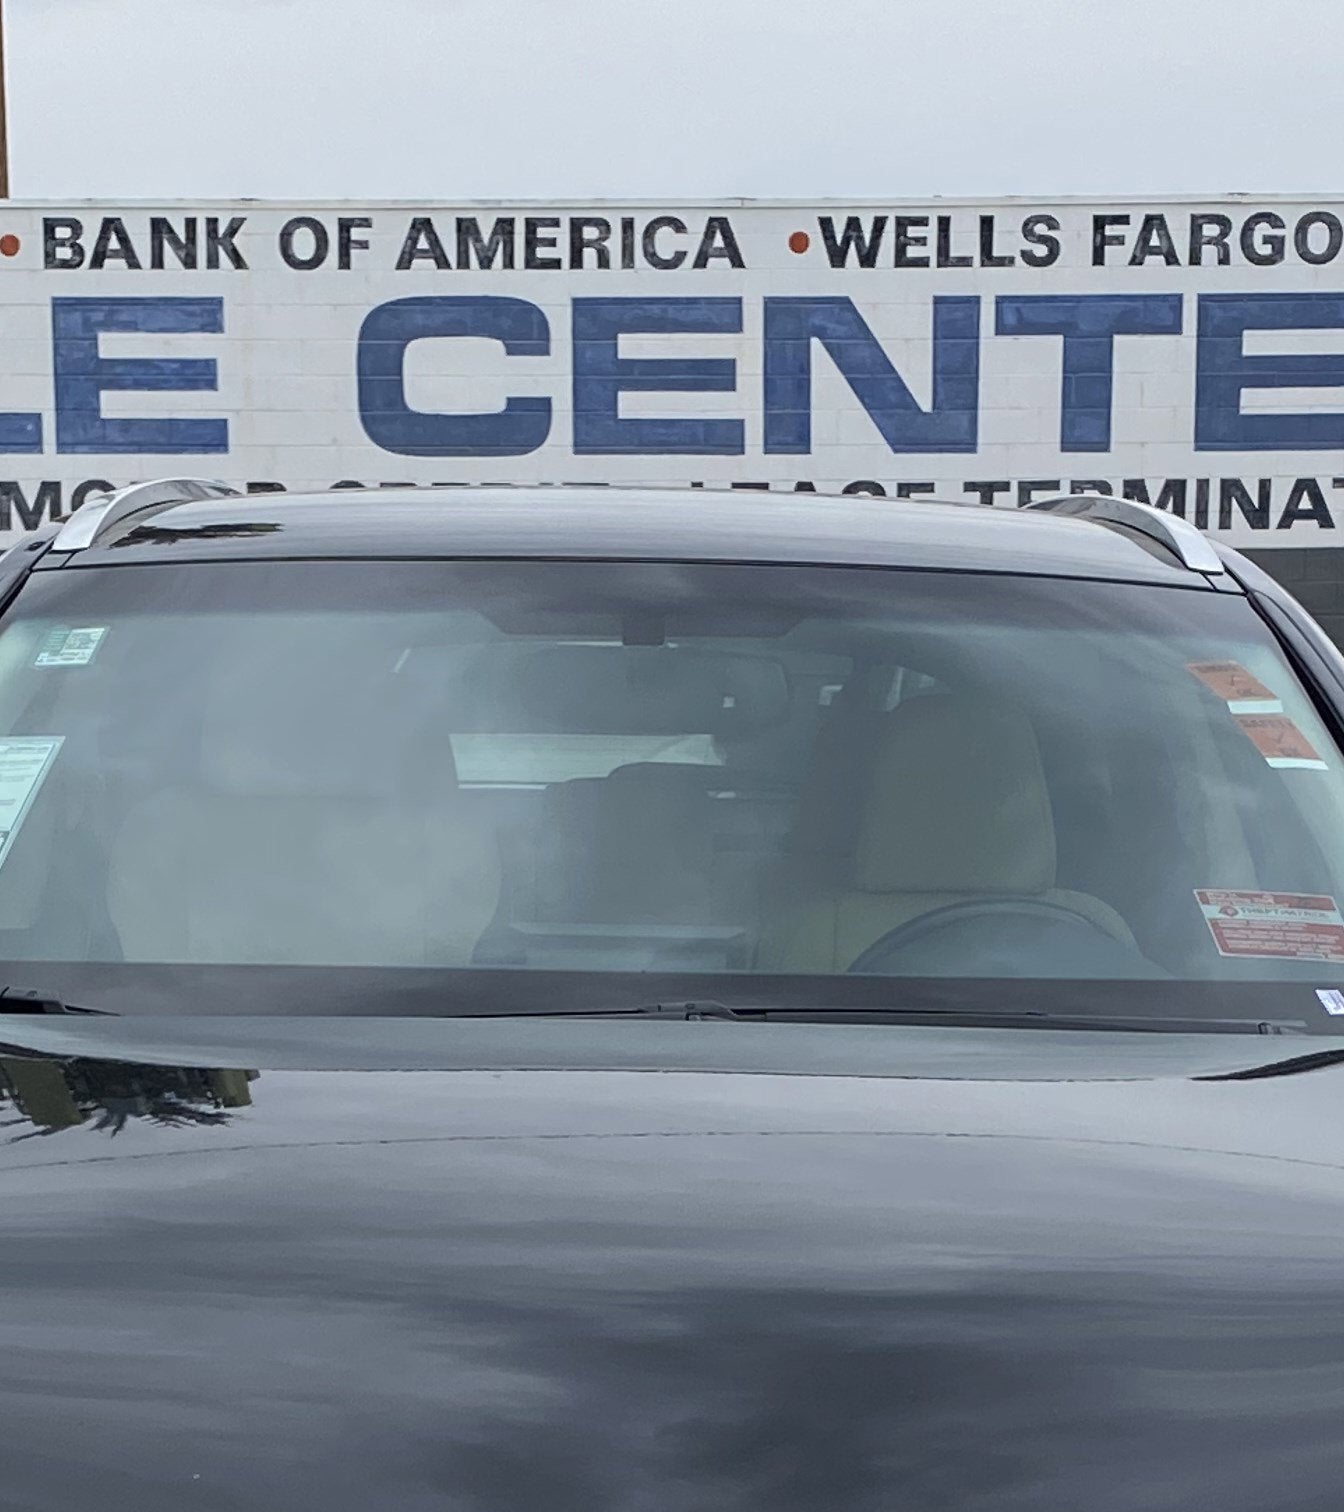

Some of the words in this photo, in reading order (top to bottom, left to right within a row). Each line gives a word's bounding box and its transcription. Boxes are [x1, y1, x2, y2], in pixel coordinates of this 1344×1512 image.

[42, 216, 249, 271] BANK
[278, 216, 373, 271] OF
[394, 215, 747, 271] AMERICA
[816, 214, 1062, 269] WELLS
[1090, 210, 1344, 267] FARGO
